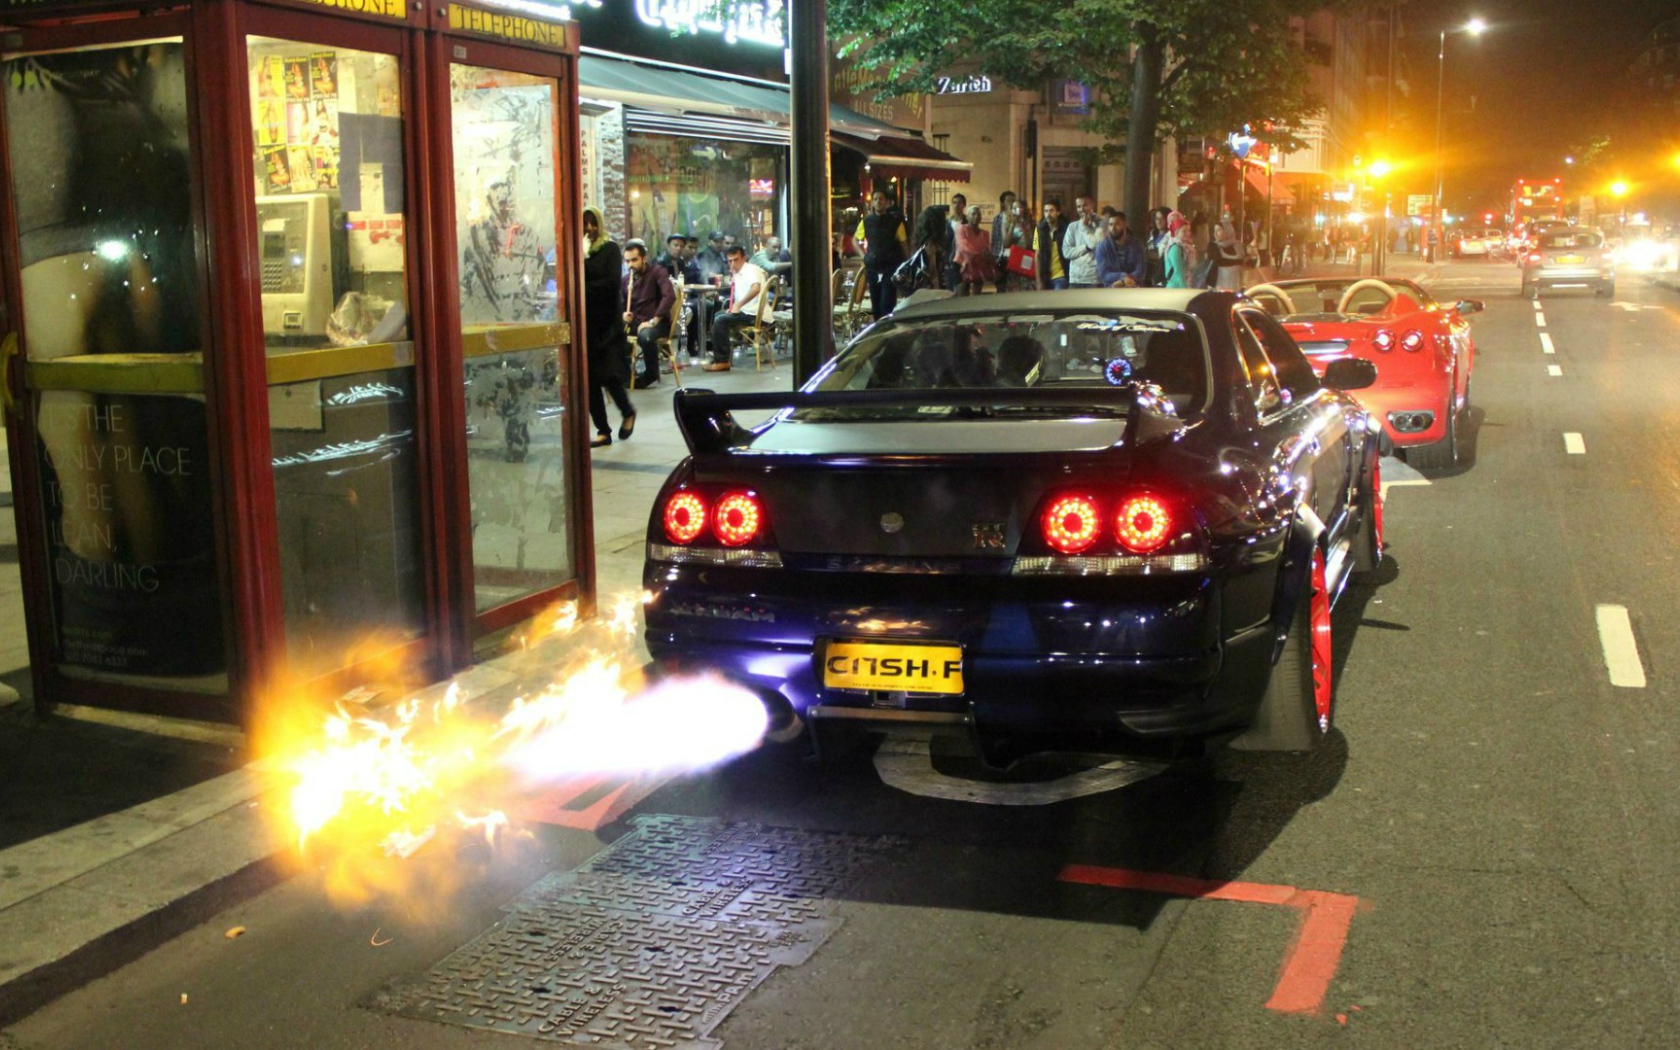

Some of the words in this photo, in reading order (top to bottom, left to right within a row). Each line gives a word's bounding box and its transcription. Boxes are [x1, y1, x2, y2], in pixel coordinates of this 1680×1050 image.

[457, 6, 559, 47] TELEPHONE
[869, 102, 895, 123] SIZES
[79, 403, 124, 433] THE
[44, 443, 107, 472] ONLY
[114, 445, 191, 476] PLACE
[48, 481, 78, 509] TO
[86, 482, 113, 511] BE
[55, 558, 160, 593] DARLING
[682, 889, 722, 915] CABLE
[699, 878, 754, 917] WIRELESS
[543, 919, 608, 962] WIRELESS
[538, 997, 588, 1033] CABLE
[557, 984, 627, 1036] WIRELESS
